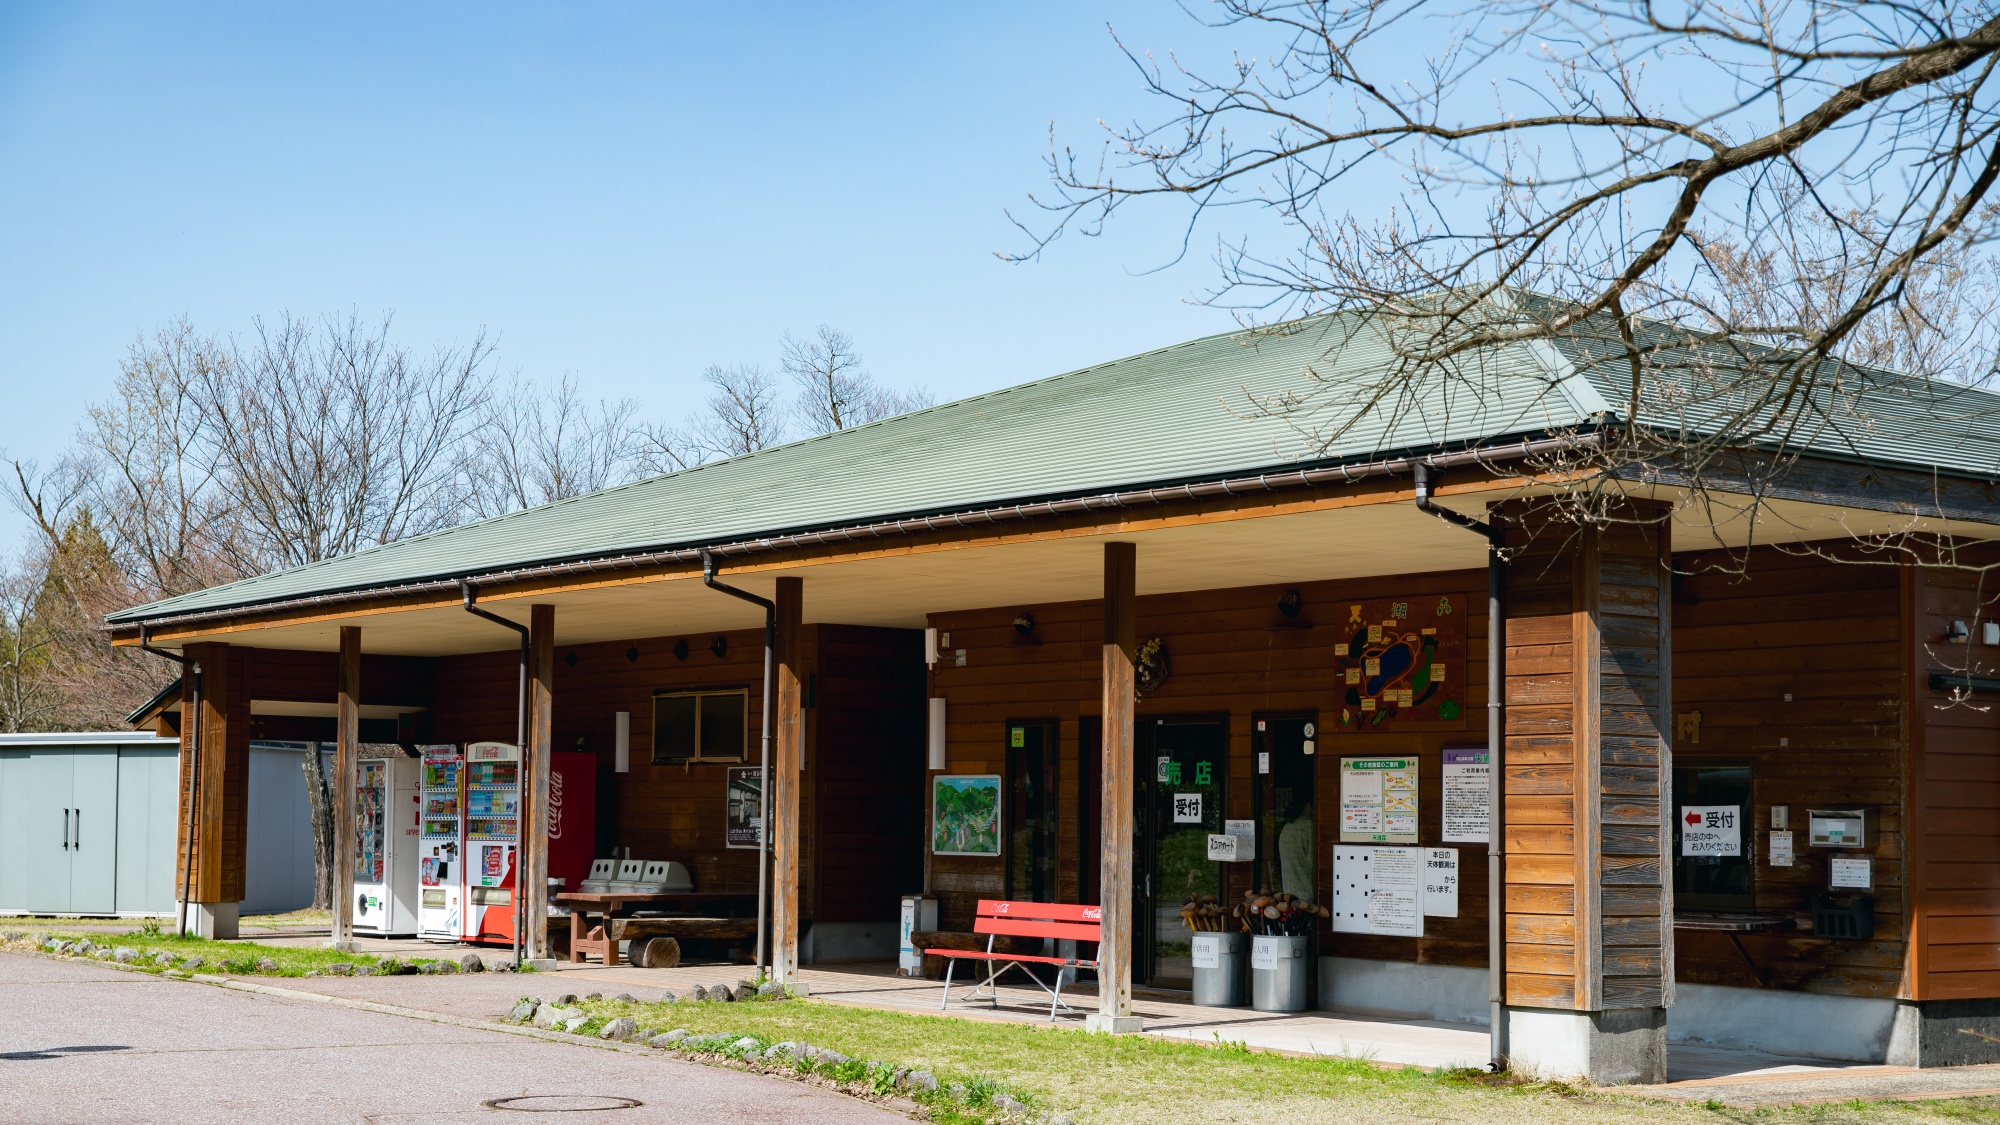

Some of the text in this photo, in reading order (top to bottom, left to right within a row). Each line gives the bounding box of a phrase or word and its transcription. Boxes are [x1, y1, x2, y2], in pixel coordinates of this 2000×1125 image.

[1175, 798, 1200, 817] 受付
[1705, 810, 1735, 829] 受付
[1684, 832, 1721, 842] 売店の中へ
[1691, 842, 1738, 852] お入りください
[1432, 851, 1451, 859] 本日の
[1426, 860, 1456, 869] 天体観測は
[1444, 875, 1456, 884] から
[1426, 884, 1452, 894] 行います。
